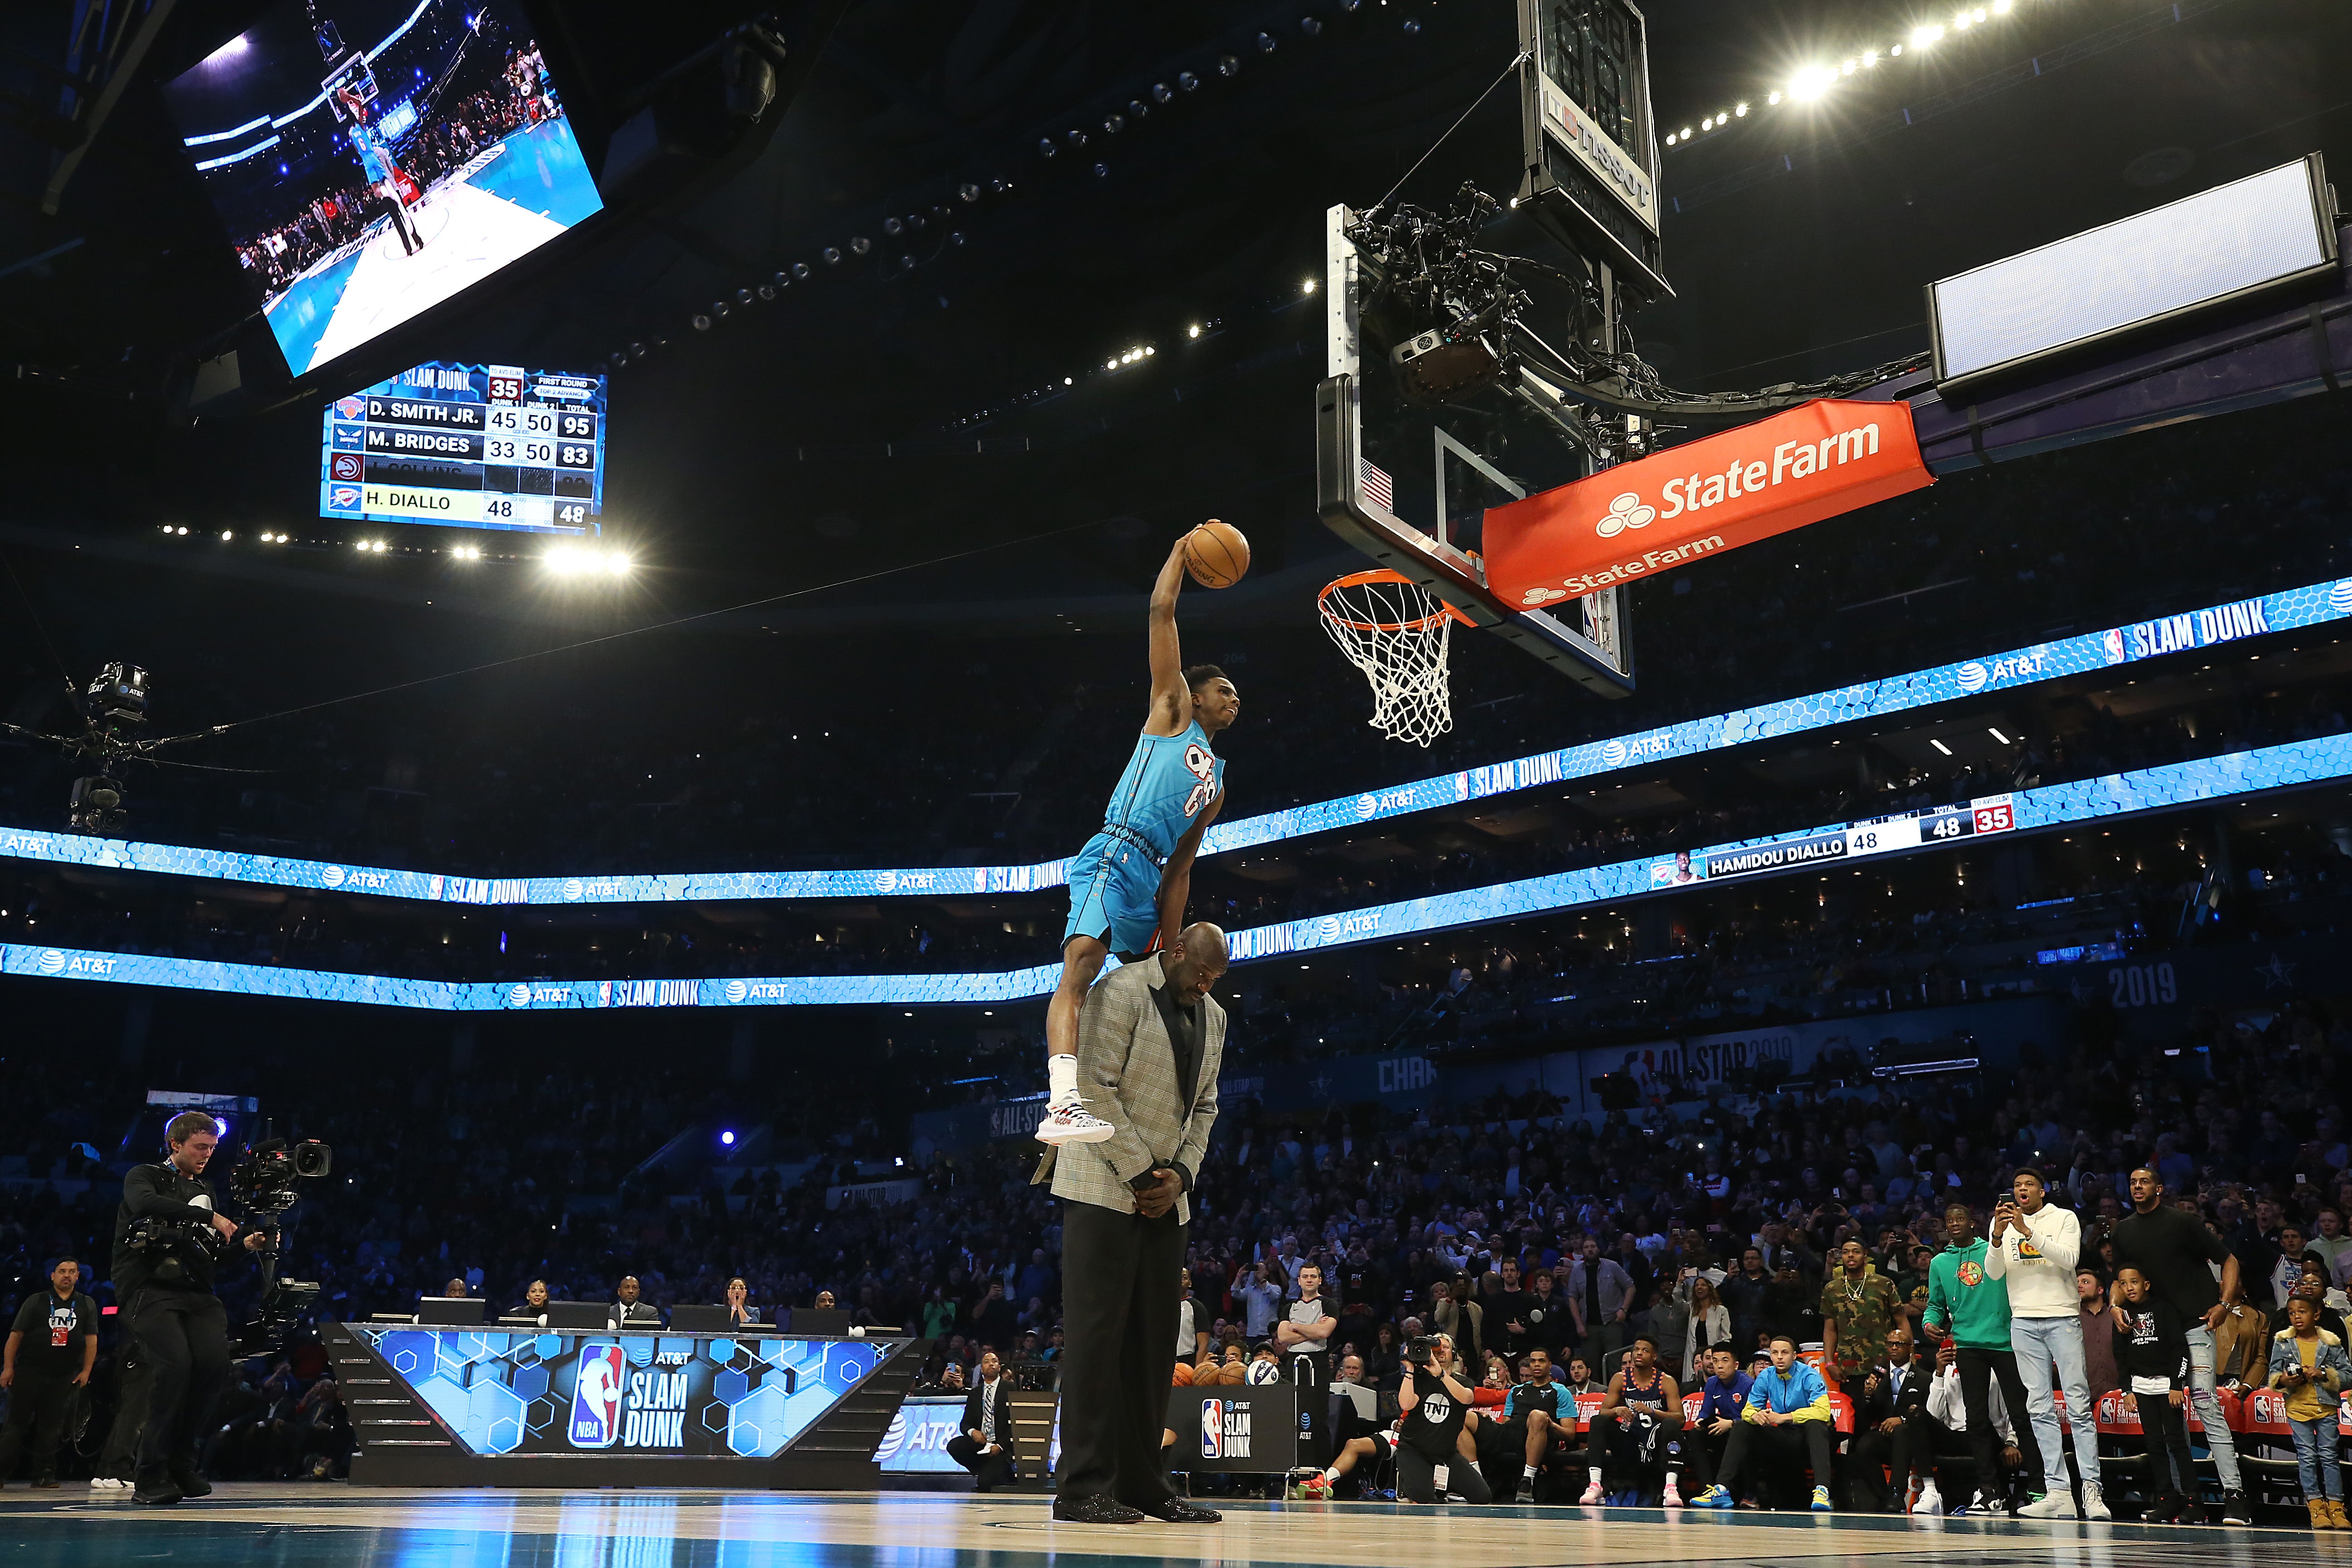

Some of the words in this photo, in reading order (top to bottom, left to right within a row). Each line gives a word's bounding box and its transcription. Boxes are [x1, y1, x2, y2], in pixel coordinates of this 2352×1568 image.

[1577, 120, 1650, 209] TISSOT
[403, 368, 434, 389] SLAM
[436, 370, 470, 392] DUNK
[490, 379, 518, 398] 35
[539, 377, 558, 386] FIRST
[563, 378, 588, 388] ROUND
[559, 390, 585, 398] ADVANCE
[369, 401, 386, 416] D.
[391, 403, 448, 422] SMITH
[451, 407, 480, 424] JR.
[491, 412, 516, 430] 45
[528, 415, 552, 432] 50
[563, 416, 590, 435] 95
[368, 429, 390, 446] M.
[394, 431, 470, 453] BRIDGES
[490, 441, 515, 458] 33
[525, 444, 551, 461] 50
[562, 446, 588, 465] 83
[367, 492, 383, 505] H.
[389, 493, 451, 510] DIALLO
[487, 500, 513, 517] 48
[559, 505, 585, 524] 48
[2133, 613, 2195, 658] SLAM
[2200, 599, 2269, 643] DUNK
[1992, 652, 2045, 681] AT&T
[128, 688, 145, 698] AT&T
[1629, 734, 1672, 758] AT&T
[1474, 764, 1515, 797] SLAM
[1518, 752, 1563, 786] DUNK
[1378, 788, 1416, 812] AT&T
[1933, 804, 1958, 814] TOTAL
[1853, 819, 1871, 828] DUNK
[1887, 814, 1906, 822] DUNK
[1932, 815, 1961, 838] 48
[1976, 808, 2010, 831] 35
[5, 835, 53, 853] AT&T
[1853, 833, 1878, 850] 48
[1710, 849, 1784, 876] HAMIDOU
[1787, 839, 1843, 865] DIALLO
[347, 872, 389, 888] AT&T
[898, 874, 937, 889] AT&T
[992, 866, 1030, 892] SLAM
[1033, 861, 1064, 888] DUNK
[450, 879, 489, 904] SLAM
[491, 879, 529, 904] DUNK
[585, 882, 622, 897] AT&T
[1343, 913, 1382, 933] AT&T
[1225, 927, 1252, 960] LAM
[1256, 923, 1294, 955] DUNK
[69, 956, 117, 974] AT&T
[533, 987, 571, 1003] AT&T
[617, 982, 657, 1007] SLAM
[659, 981, 700, 1006] DUNK
[749, 984, 788, 999] AT&T
[2108, 962, 2177, 1009] 2019
[2010, 1237, 2019, 1261] GUCCI
[655, 1352, 691, 1364] AT&T
[629, 1372, 688, 1410] SLAM
[1234, 1401, 1251, 1410] AT&T
[1424, 1401, 1450, 1416] TNT
[575, 1420, 599, 1439] NBA
[624, 1411, 686, 1448] DUNK
[1224, 1412, 1251, 1436] SLAM
[1639, 1412, 1652, 1428] 5
[909, 1421, 960, 1452] AT&
[1299, 1432, 1312, 1440] AT&T
[1204, 1444, 1215, 1455] NBA
[1224, 1436, 1251, 1458] DUNK
